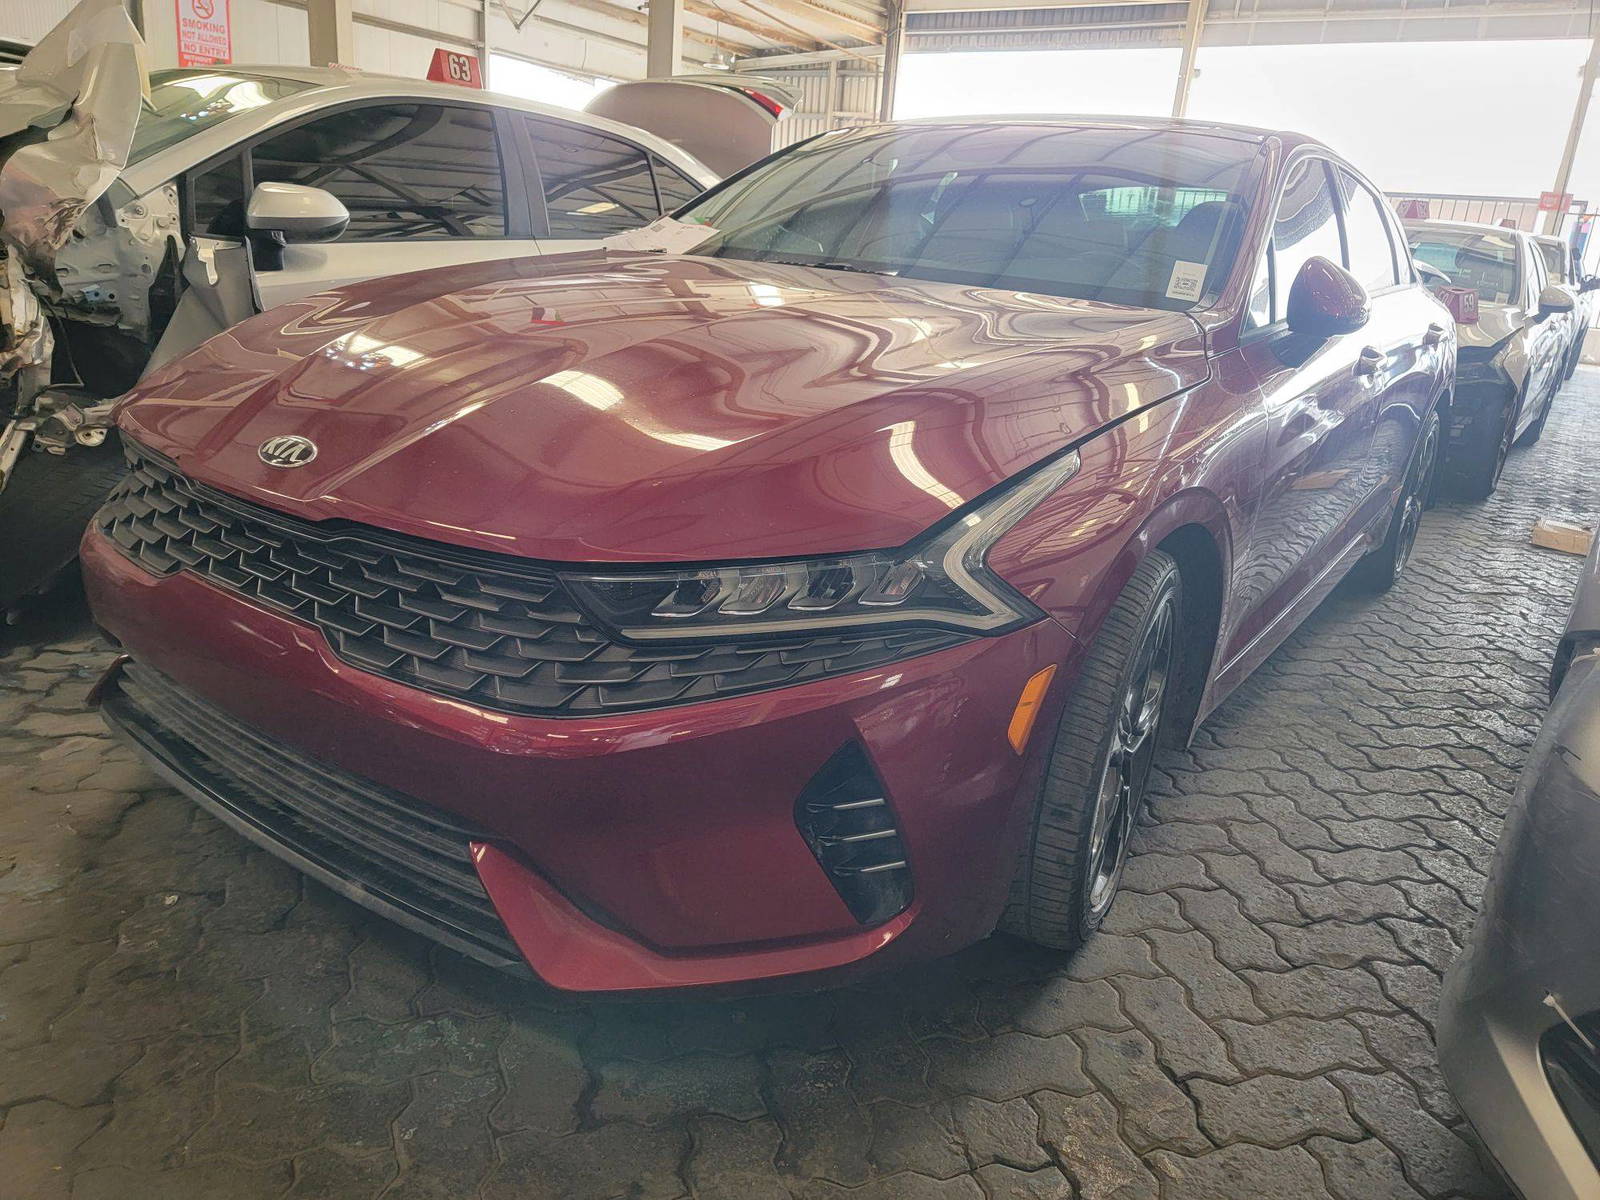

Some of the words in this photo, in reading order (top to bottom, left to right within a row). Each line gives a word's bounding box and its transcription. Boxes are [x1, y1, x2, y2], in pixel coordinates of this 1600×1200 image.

[182, 18, 226, 34] SMOKING
[182, 30, 196, 41] NOT
[197, 33, 227, 46] ALLOWED
[183, 42, 197, 53] NO
[199, 45, 227, 57] ENTRY
[448, 53, 472, 82] 63
[261, 437, 308, 463] KIA
